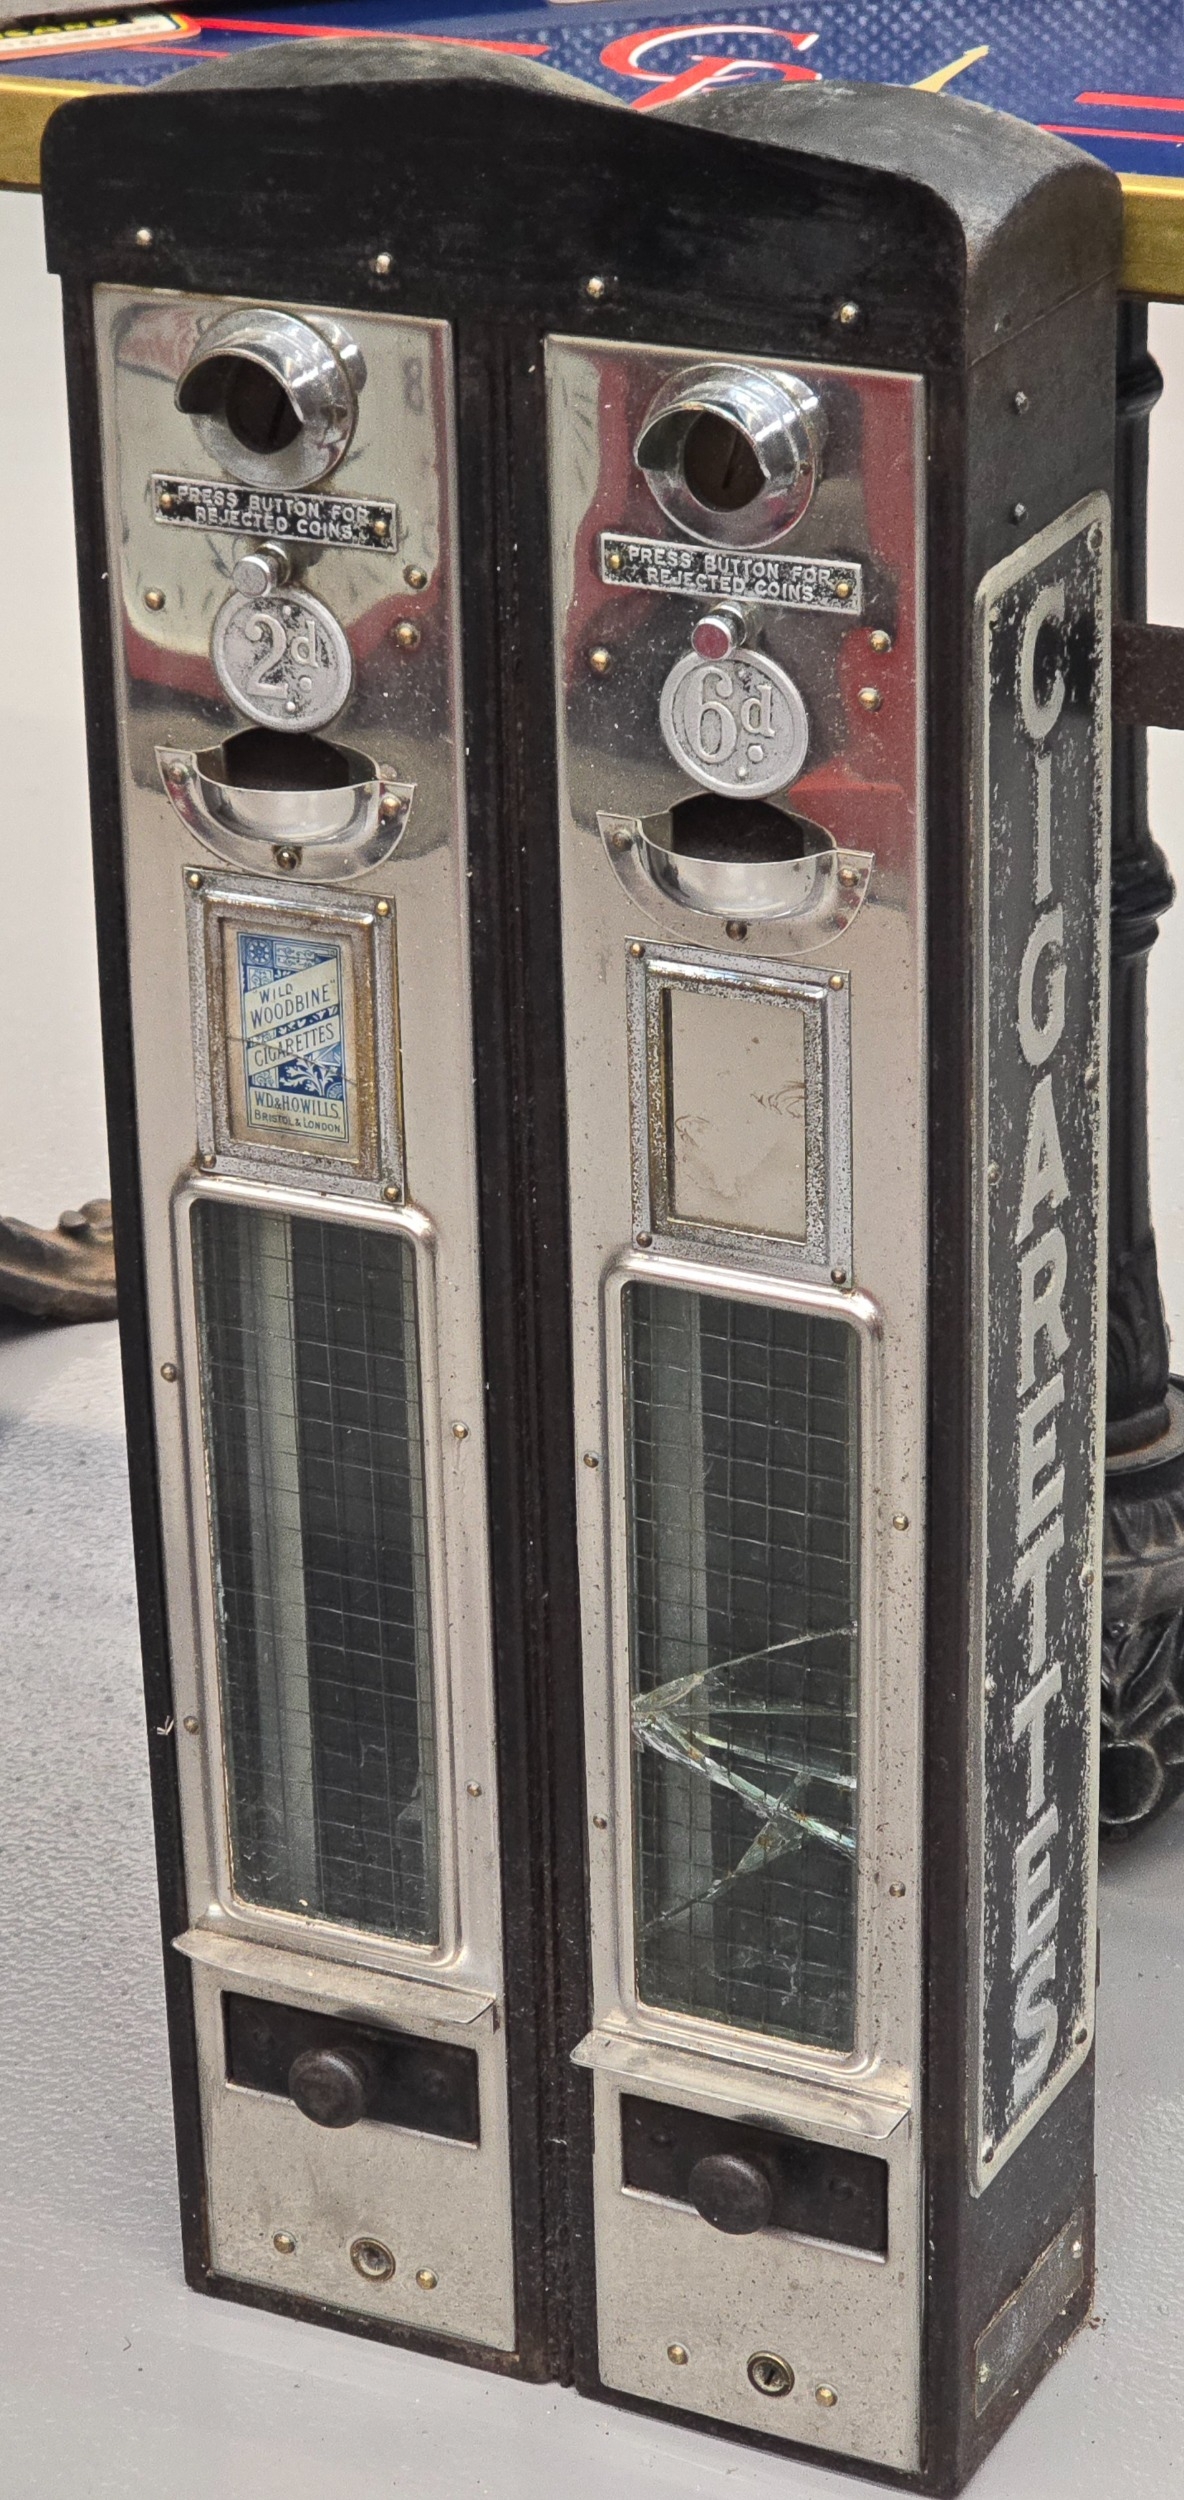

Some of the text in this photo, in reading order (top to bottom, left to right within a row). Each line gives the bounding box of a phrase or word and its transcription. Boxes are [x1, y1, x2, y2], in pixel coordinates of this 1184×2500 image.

[178, 486, 370, 523] PRESS BUTTON FOR
[195, 506, 289, 532] REJECTED
[628, 544, 831, 584] PRESS BUTTON FOR
[646, 567, 815, 601] REJECTED COINS
[254, 1022, 335, 1067] CIGARETTES
[1010, 576, 1069, 2106] CIGARETTES
